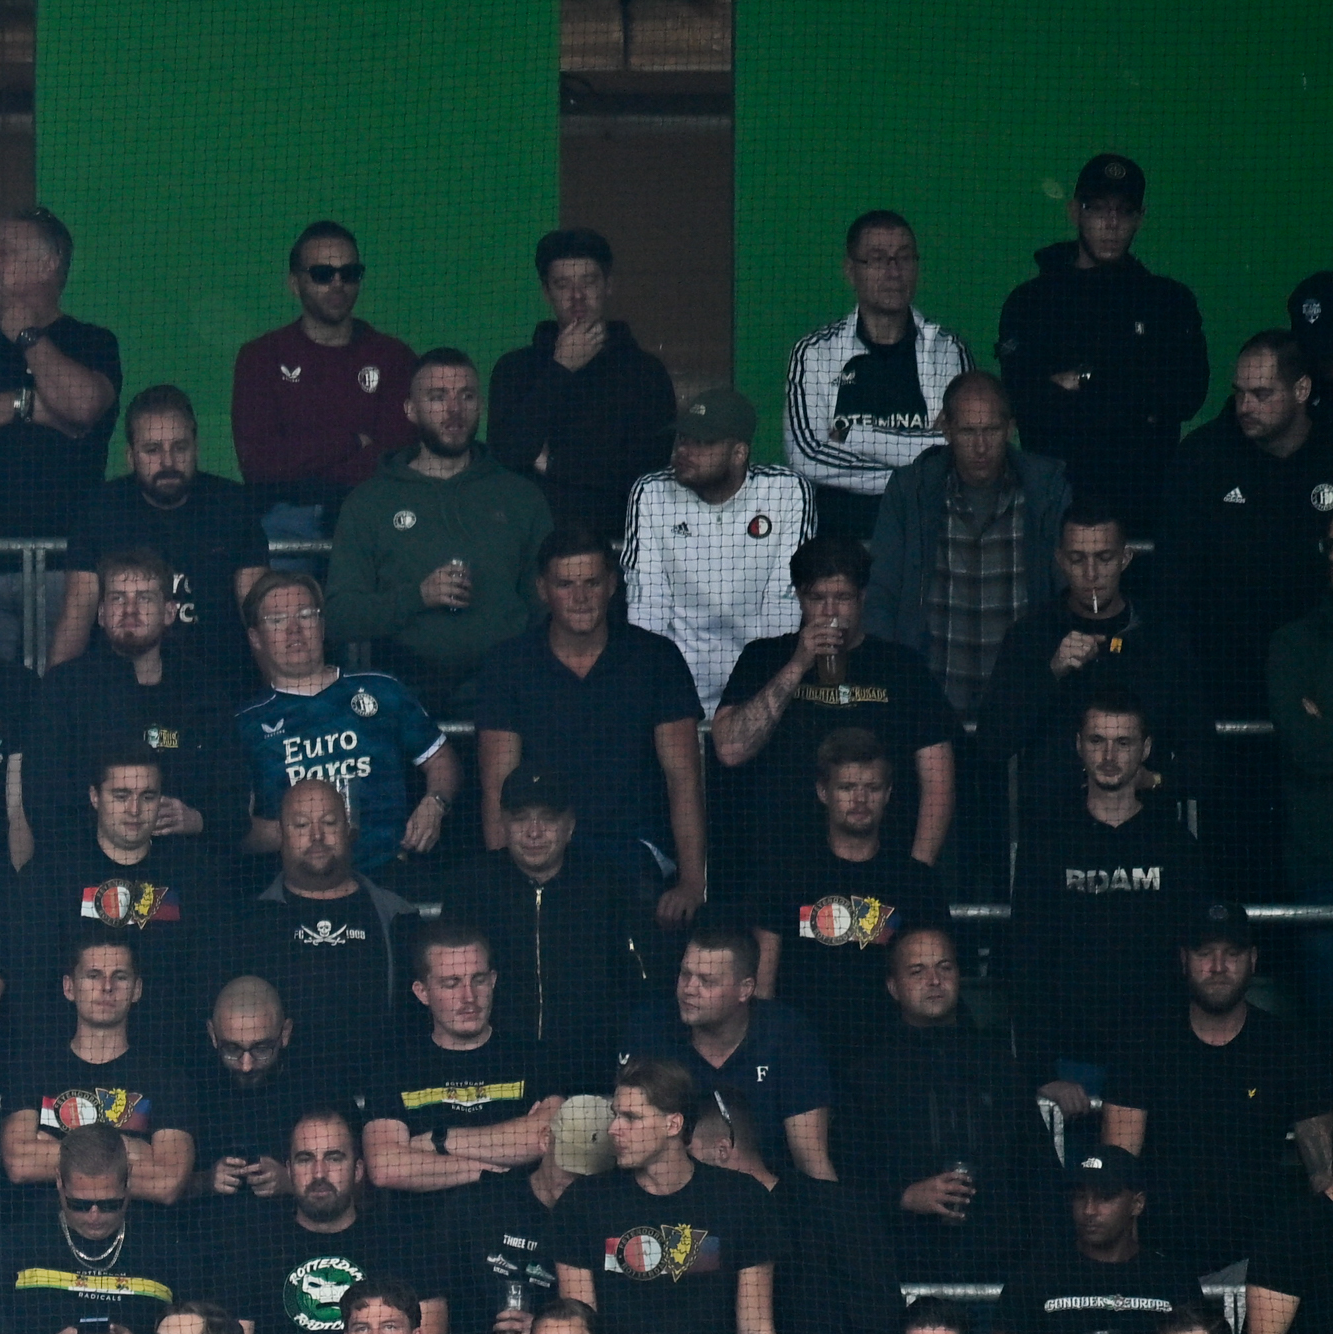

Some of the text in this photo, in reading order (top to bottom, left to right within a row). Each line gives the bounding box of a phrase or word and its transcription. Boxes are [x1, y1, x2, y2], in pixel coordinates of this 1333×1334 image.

[283, 730, 357, 765] Euro
[1066, 866, 1161, 895] RDAM
[503, 1235, 526, 1249] THREE
[289, 1257, 365, 1287] ROTTERDAM
[78, 1292, 123, 1302] RADICALS
